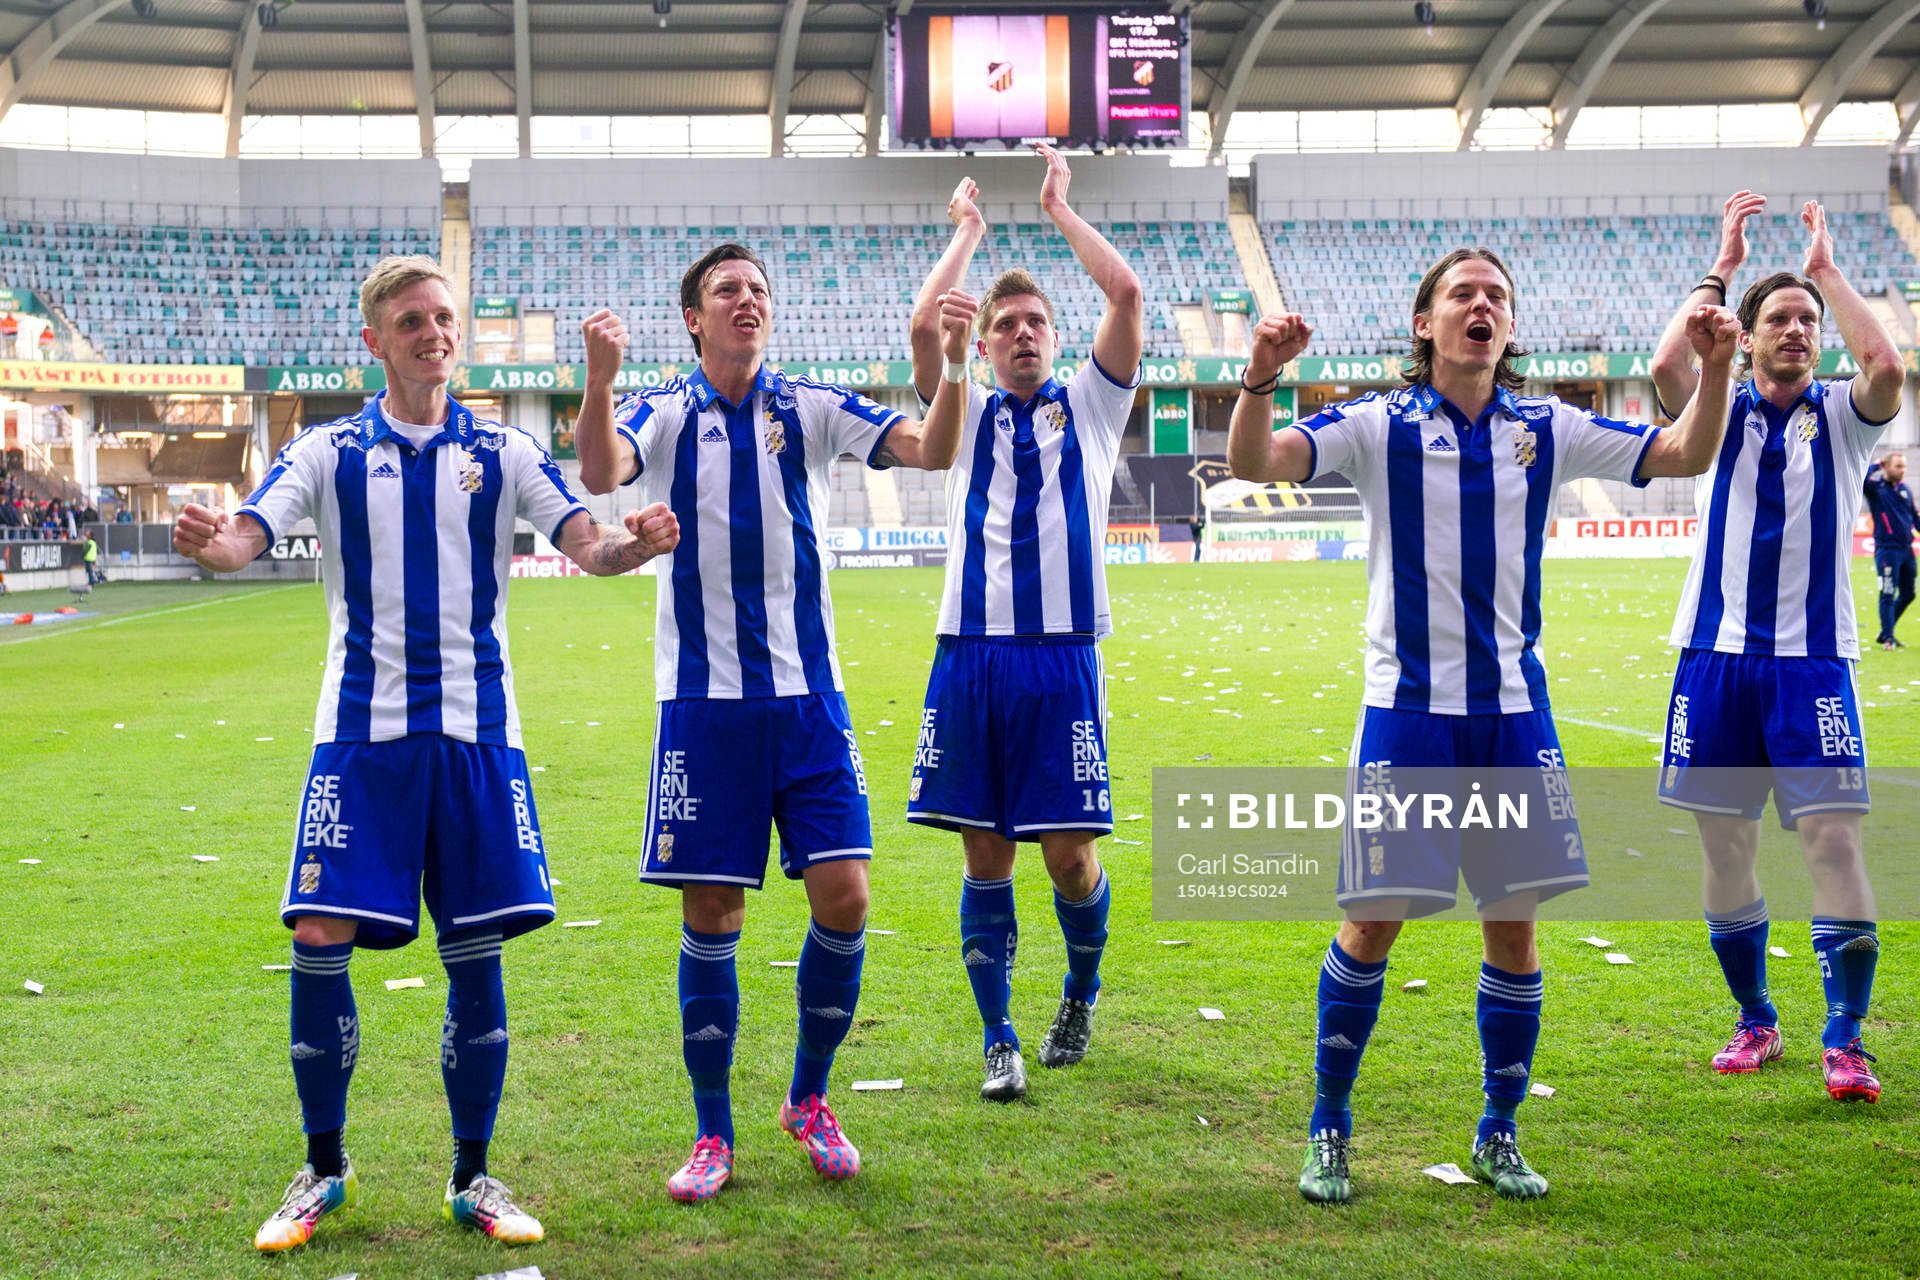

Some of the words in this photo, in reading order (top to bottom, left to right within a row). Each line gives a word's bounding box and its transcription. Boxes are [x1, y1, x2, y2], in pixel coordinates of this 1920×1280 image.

[490, 369, 555, 388] ÅBRO
[1319, 360, 1382, 380] ÅBRO
[1524, 358, 1588, 377] ÅBRO
[278, 370, 344, 390] ÅBRO
[875, 530, 947, 546] FRIGGA
[1674, 694, 1690, 717] SE
[1815, 696, 1845, 717] SE
[1071, 720, 1096, 741] SE
[1671, 713, 1689, 737] RN
[1817, 716, 1851, 737] RN
[1072, 740, 1101, 761] RN
[1669, 733, 1692, 759] EKE
[1820, 735, 1861, 757] EKE
[662, 750, 686, 774] SE
[1073, 761, 1109, 782] EKE
[1536, 748, 1565, 773] SE
[660, 773, 689, 797] RN
[1362, 760, 1392, 786] SE
[1541, 771, 1572, 797] RN
[1836, 767, 1864, 791] 13
[308, 775, 341, 799] SE
[304, 798, 342, 823] RN
[658, 796, 699, 821] EKE
[1082, 788, 1110, 812] 16
[1546, 795, 1579, 821] EK
[302, 822, 350, 849] EKE
[1563, 831, 1581, 860] 2
